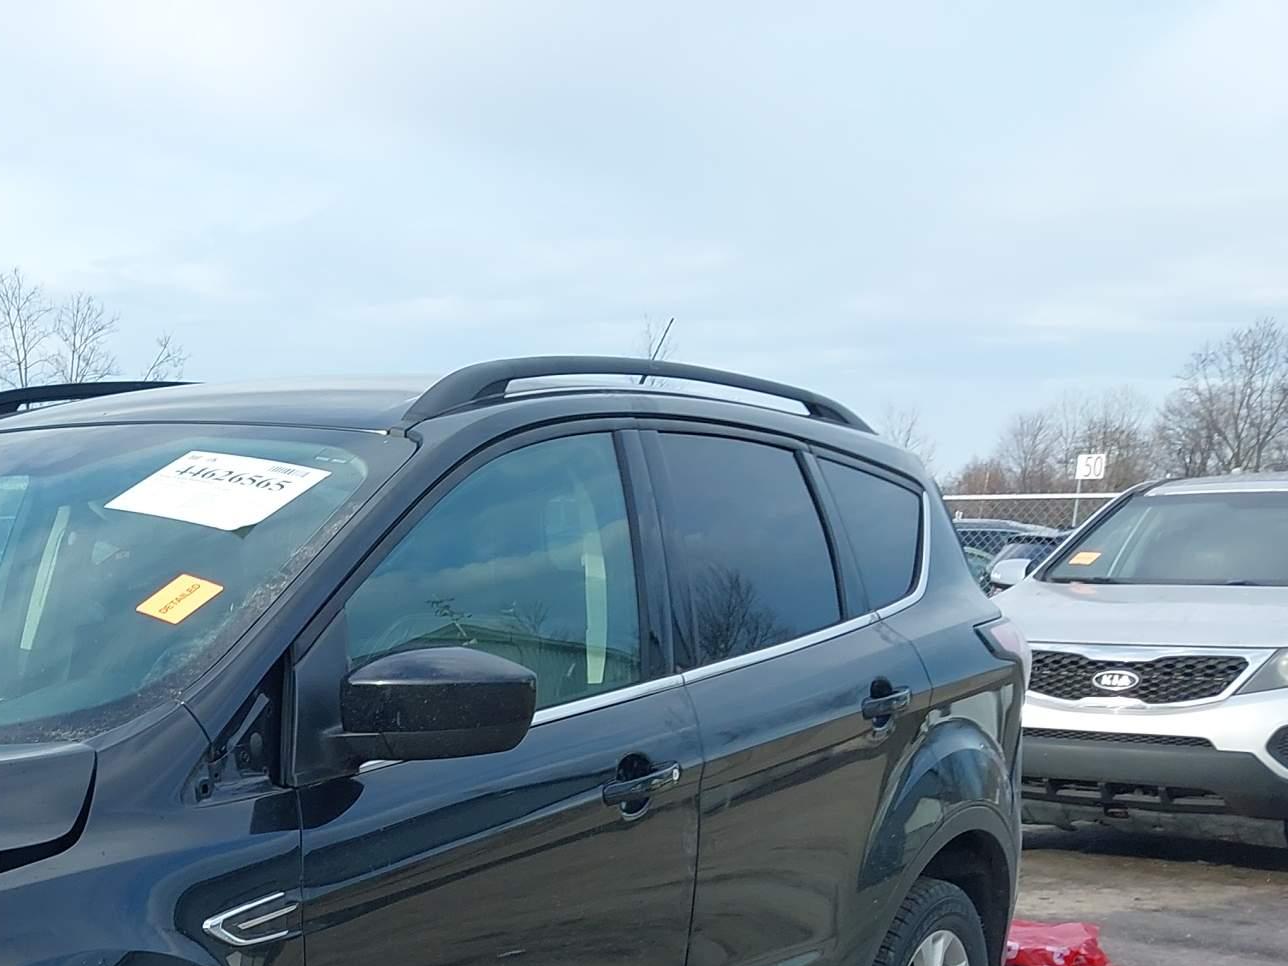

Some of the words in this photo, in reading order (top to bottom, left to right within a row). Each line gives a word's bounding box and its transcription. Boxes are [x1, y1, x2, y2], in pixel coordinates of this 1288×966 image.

[175, 465, 293, 491] 44626565
[1082, 455, 1104, 478] 50
[158, 583, 201, 615] DETAILED
[1100, 673, 1132, 687] KIA
